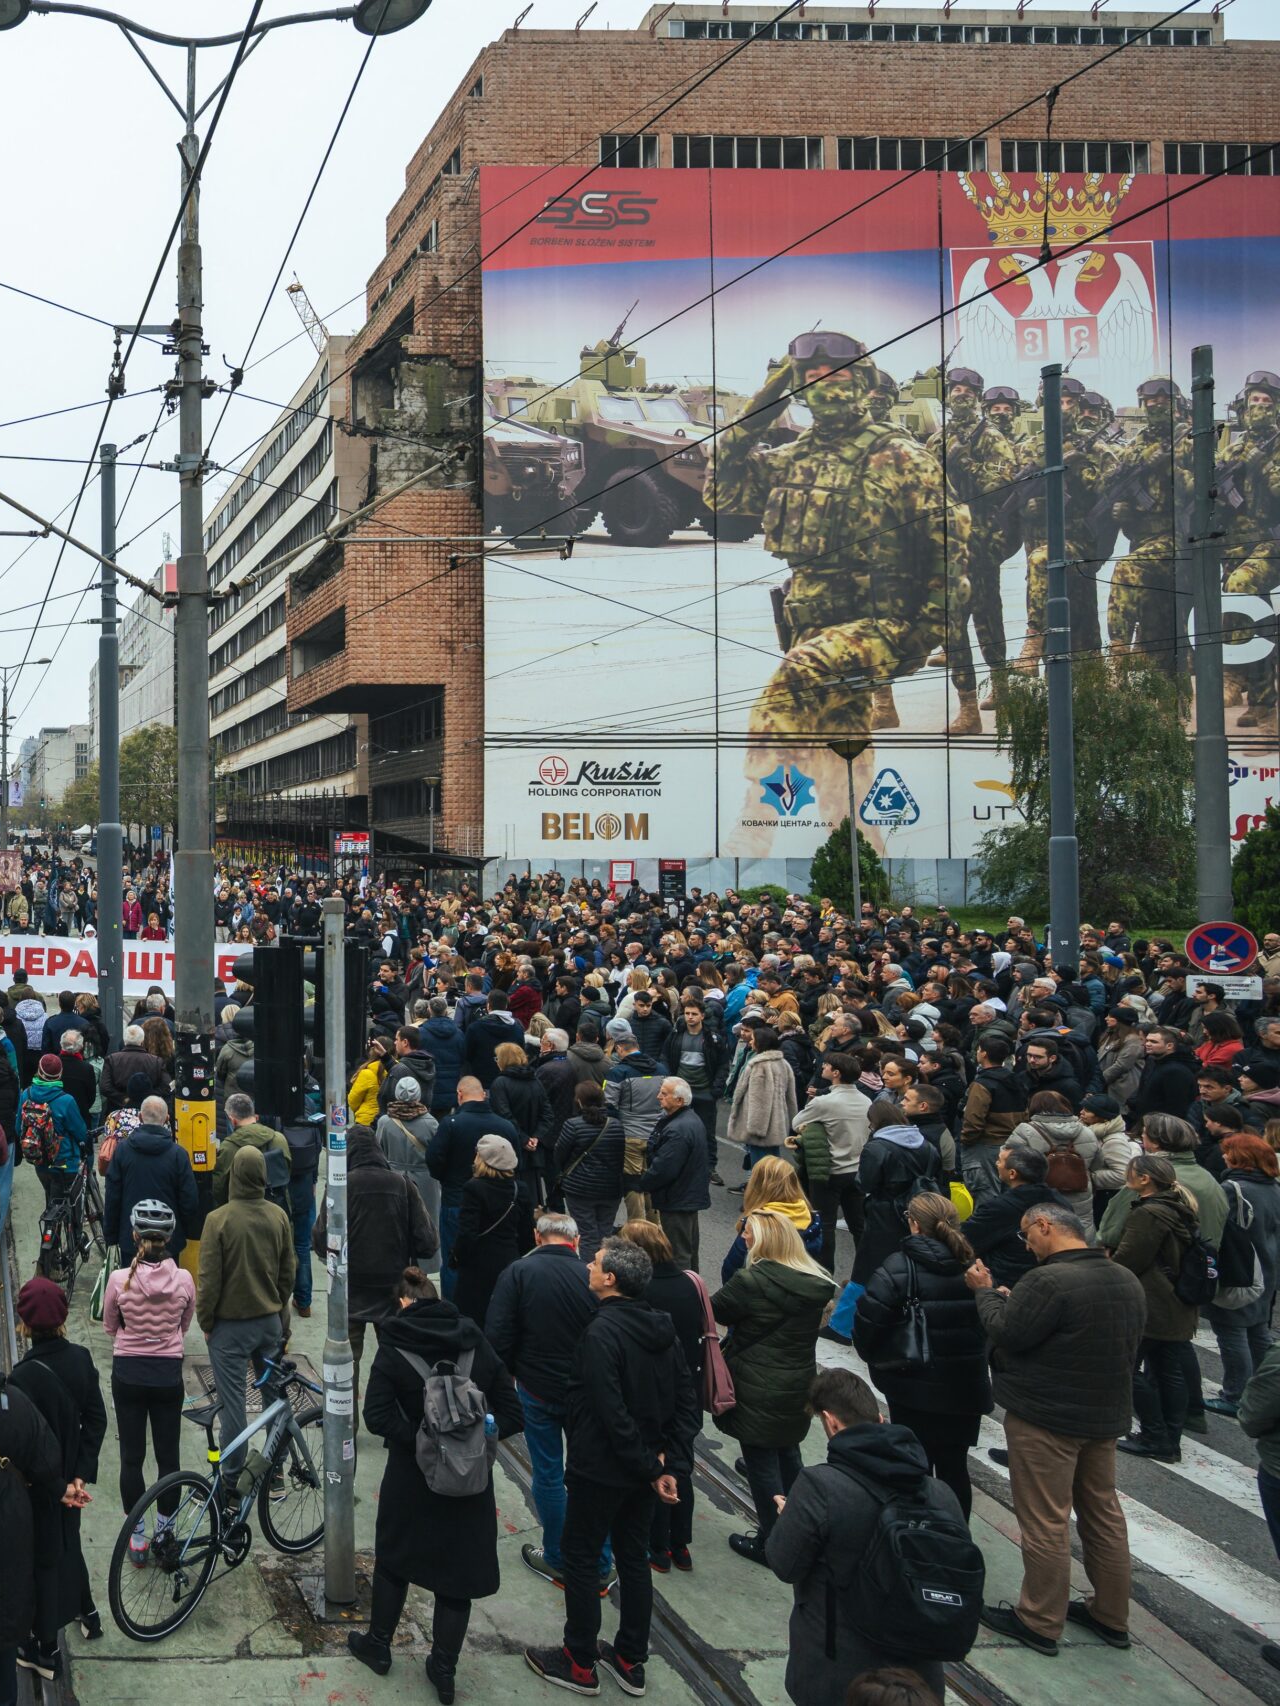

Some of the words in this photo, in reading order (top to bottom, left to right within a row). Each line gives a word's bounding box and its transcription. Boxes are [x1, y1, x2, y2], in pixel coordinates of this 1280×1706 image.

[528, 787, 579, 797] HOLDING
[581, 788, 662, 797] CORPORATION
[973, 805, 1030, 821] UTV
[541, 812, 649, 841] BELOM
[741, 819, 779, 828] КОВАЧКИ
[780, 820, 812, 829] ЦЕНТАР
